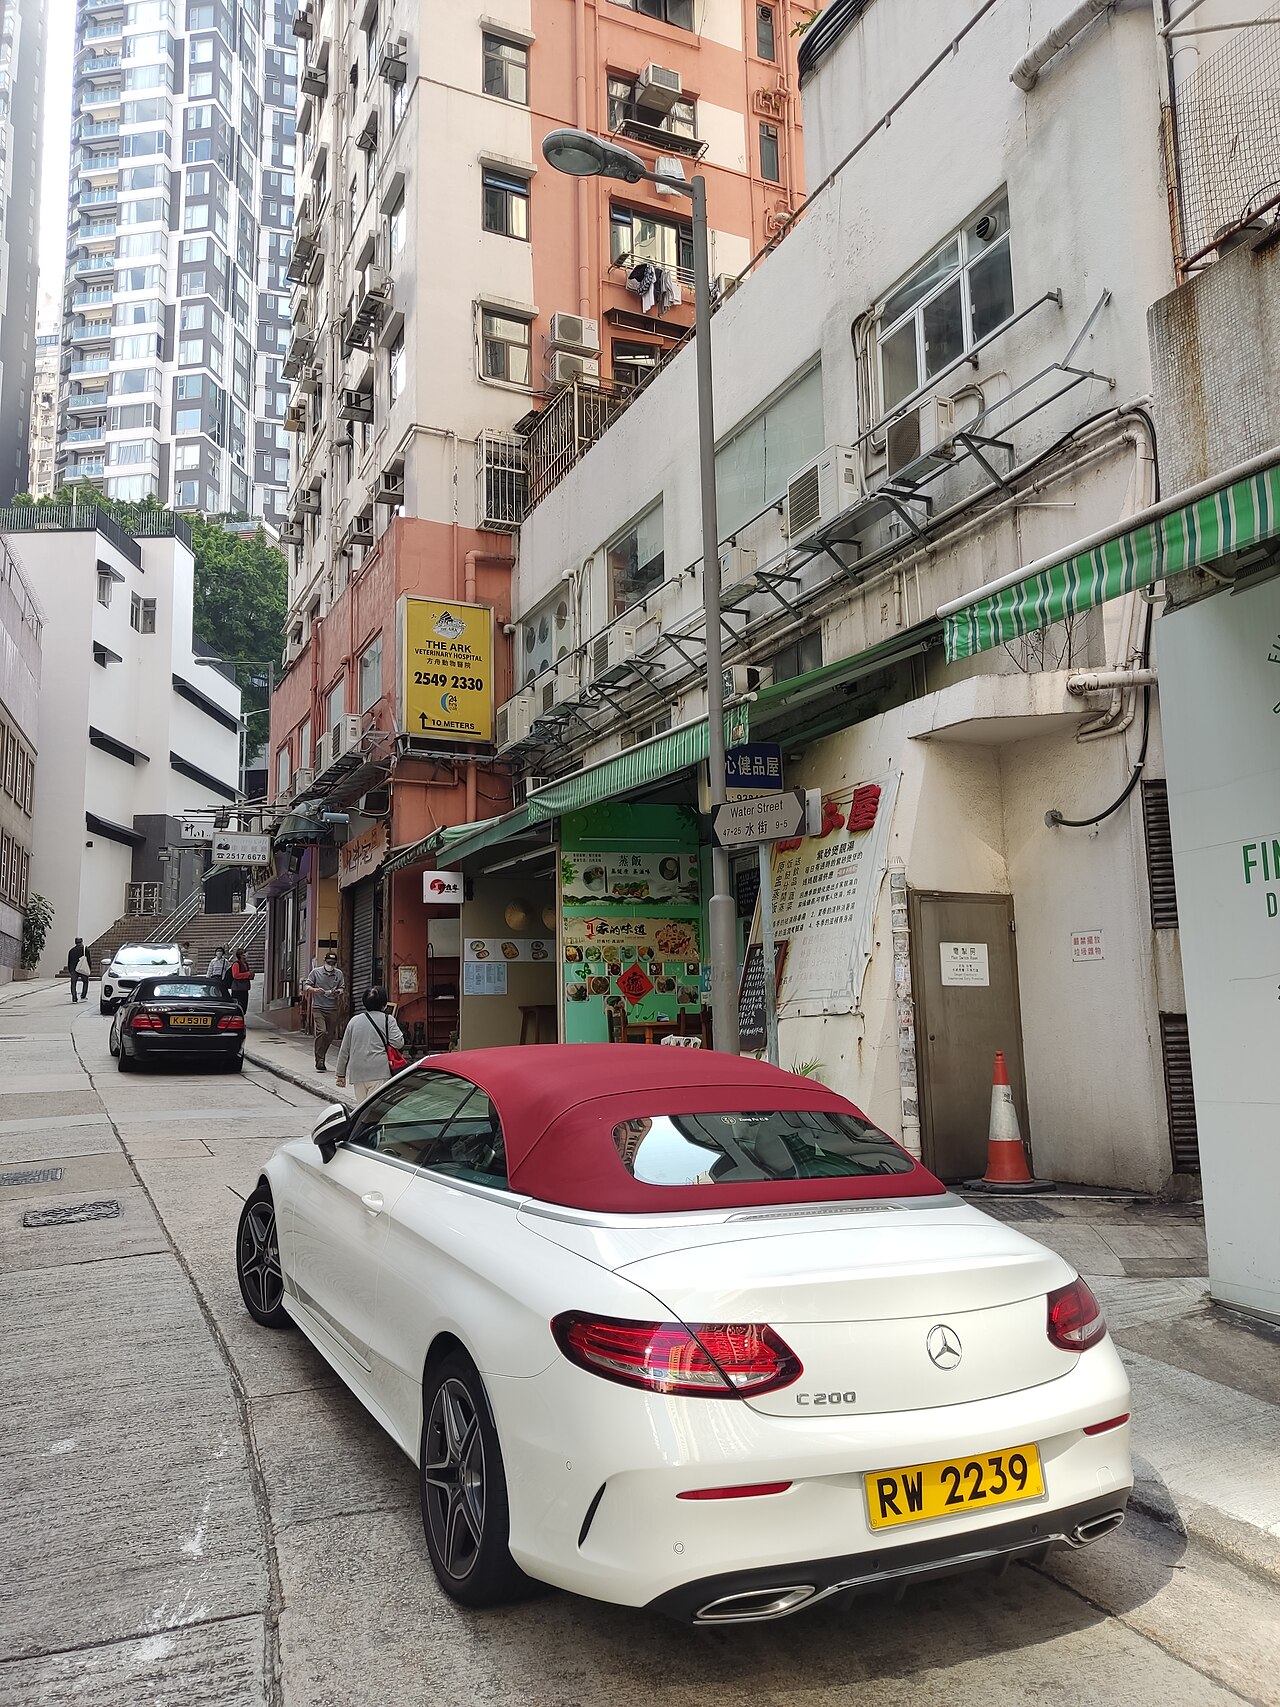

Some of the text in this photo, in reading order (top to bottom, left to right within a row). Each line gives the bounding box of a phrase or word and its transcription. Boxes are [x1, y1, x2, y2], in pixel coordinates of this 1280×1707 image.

[426, 640, 472, 653] THE ARK
[415, 648, 482, 662] VETERINARY HOSPITAL
[427, 658, 471, 668] 方舟動物醫院
[414, 671, 483, 691] 2549 2330
[444, 721, 475, 730] METERS
[727, 755, 780, 776] 心健品屋
[730, 800, 783, 818] Water Street
[723, 820, 788, 836] 47-25 水街 9-5
[797, 1392, 856, 1405] C 200
[876, 1454, 1028, 1518] RW 2239
